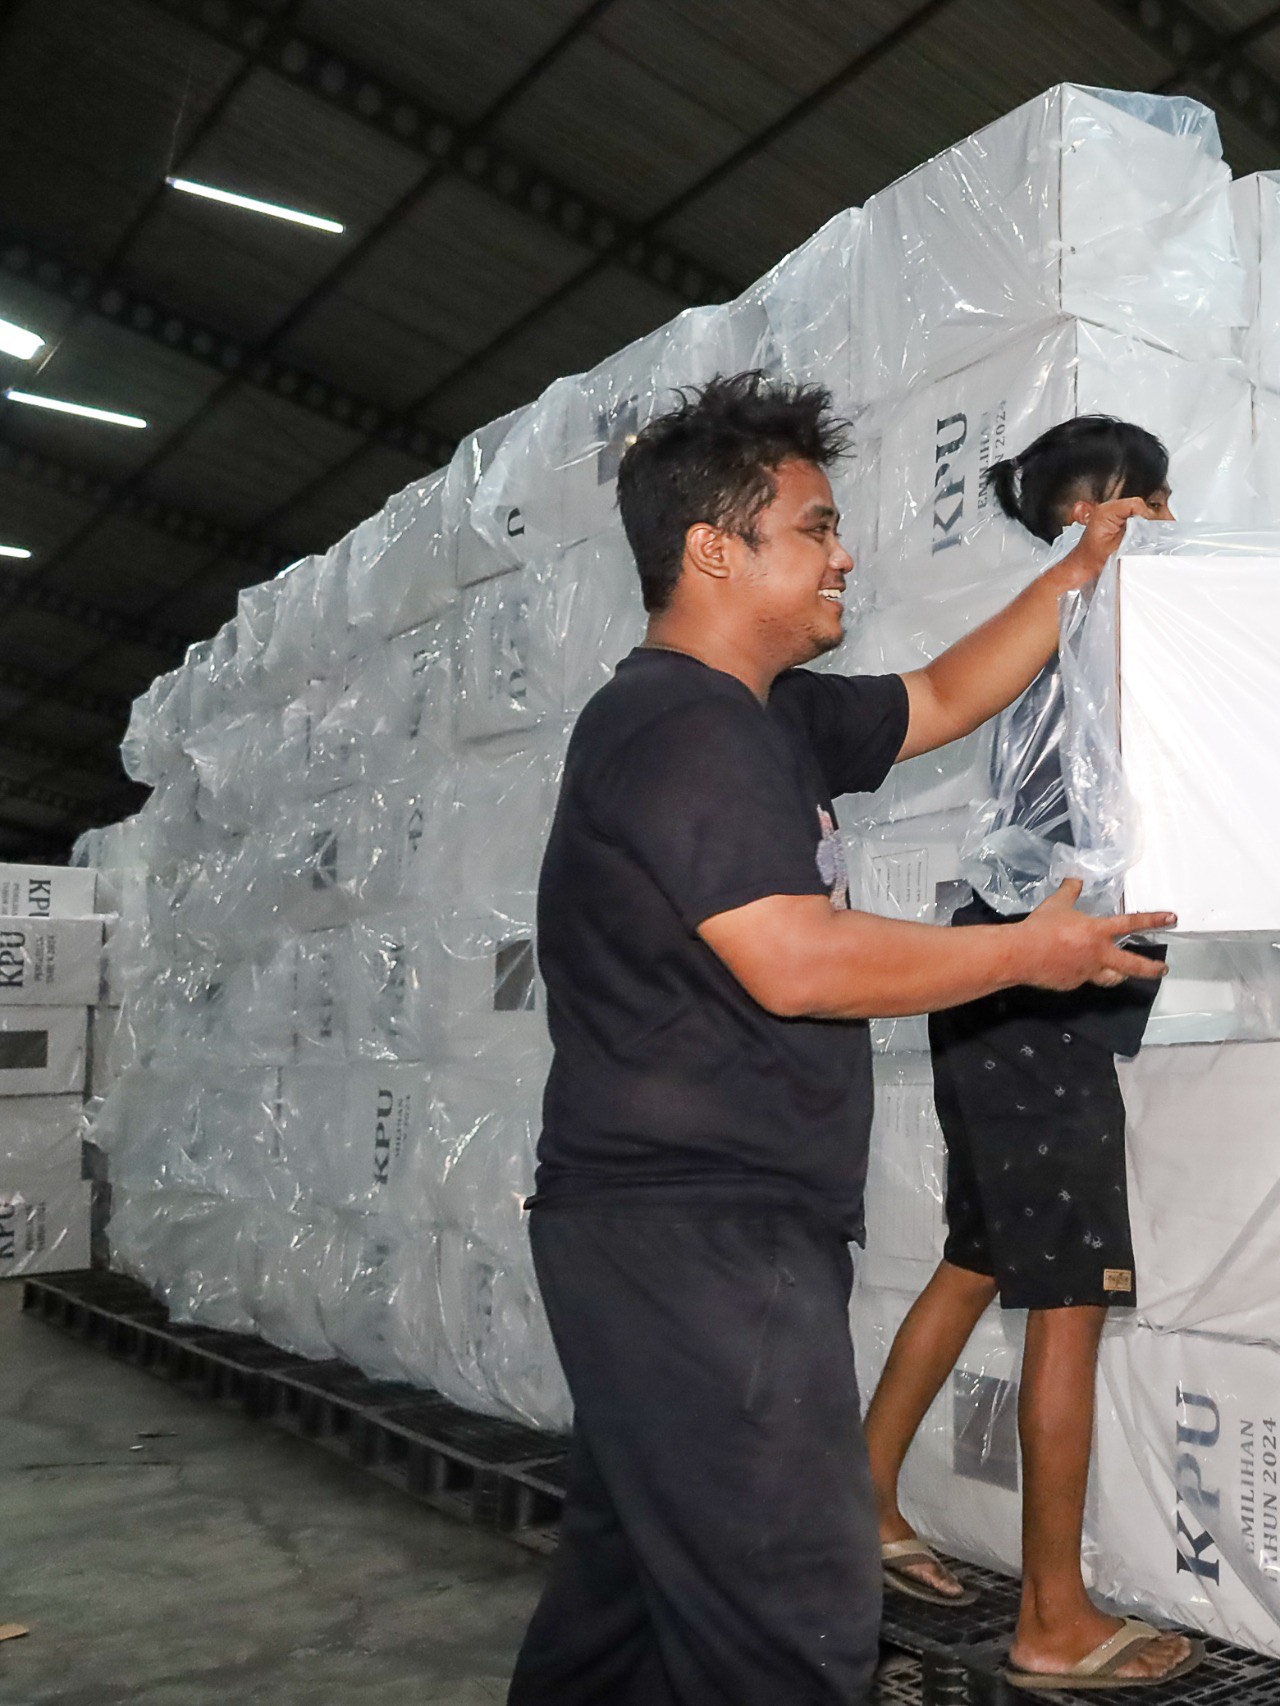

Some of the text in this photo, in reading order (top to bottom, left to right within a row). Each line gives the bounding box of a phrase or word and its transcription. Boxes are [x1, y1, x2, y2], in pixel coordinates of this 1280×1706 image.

[931, 412, 968, 557] KPU
[0, 931, 25, 987] KPU
[374, 1089, 393, 1185] KPU
[1176, 1386, 1221, 1587] KPU
[1240, 1419, 1255, 1555] EMILIHAN
[1262, 1417, 1278, 1485] 2024
